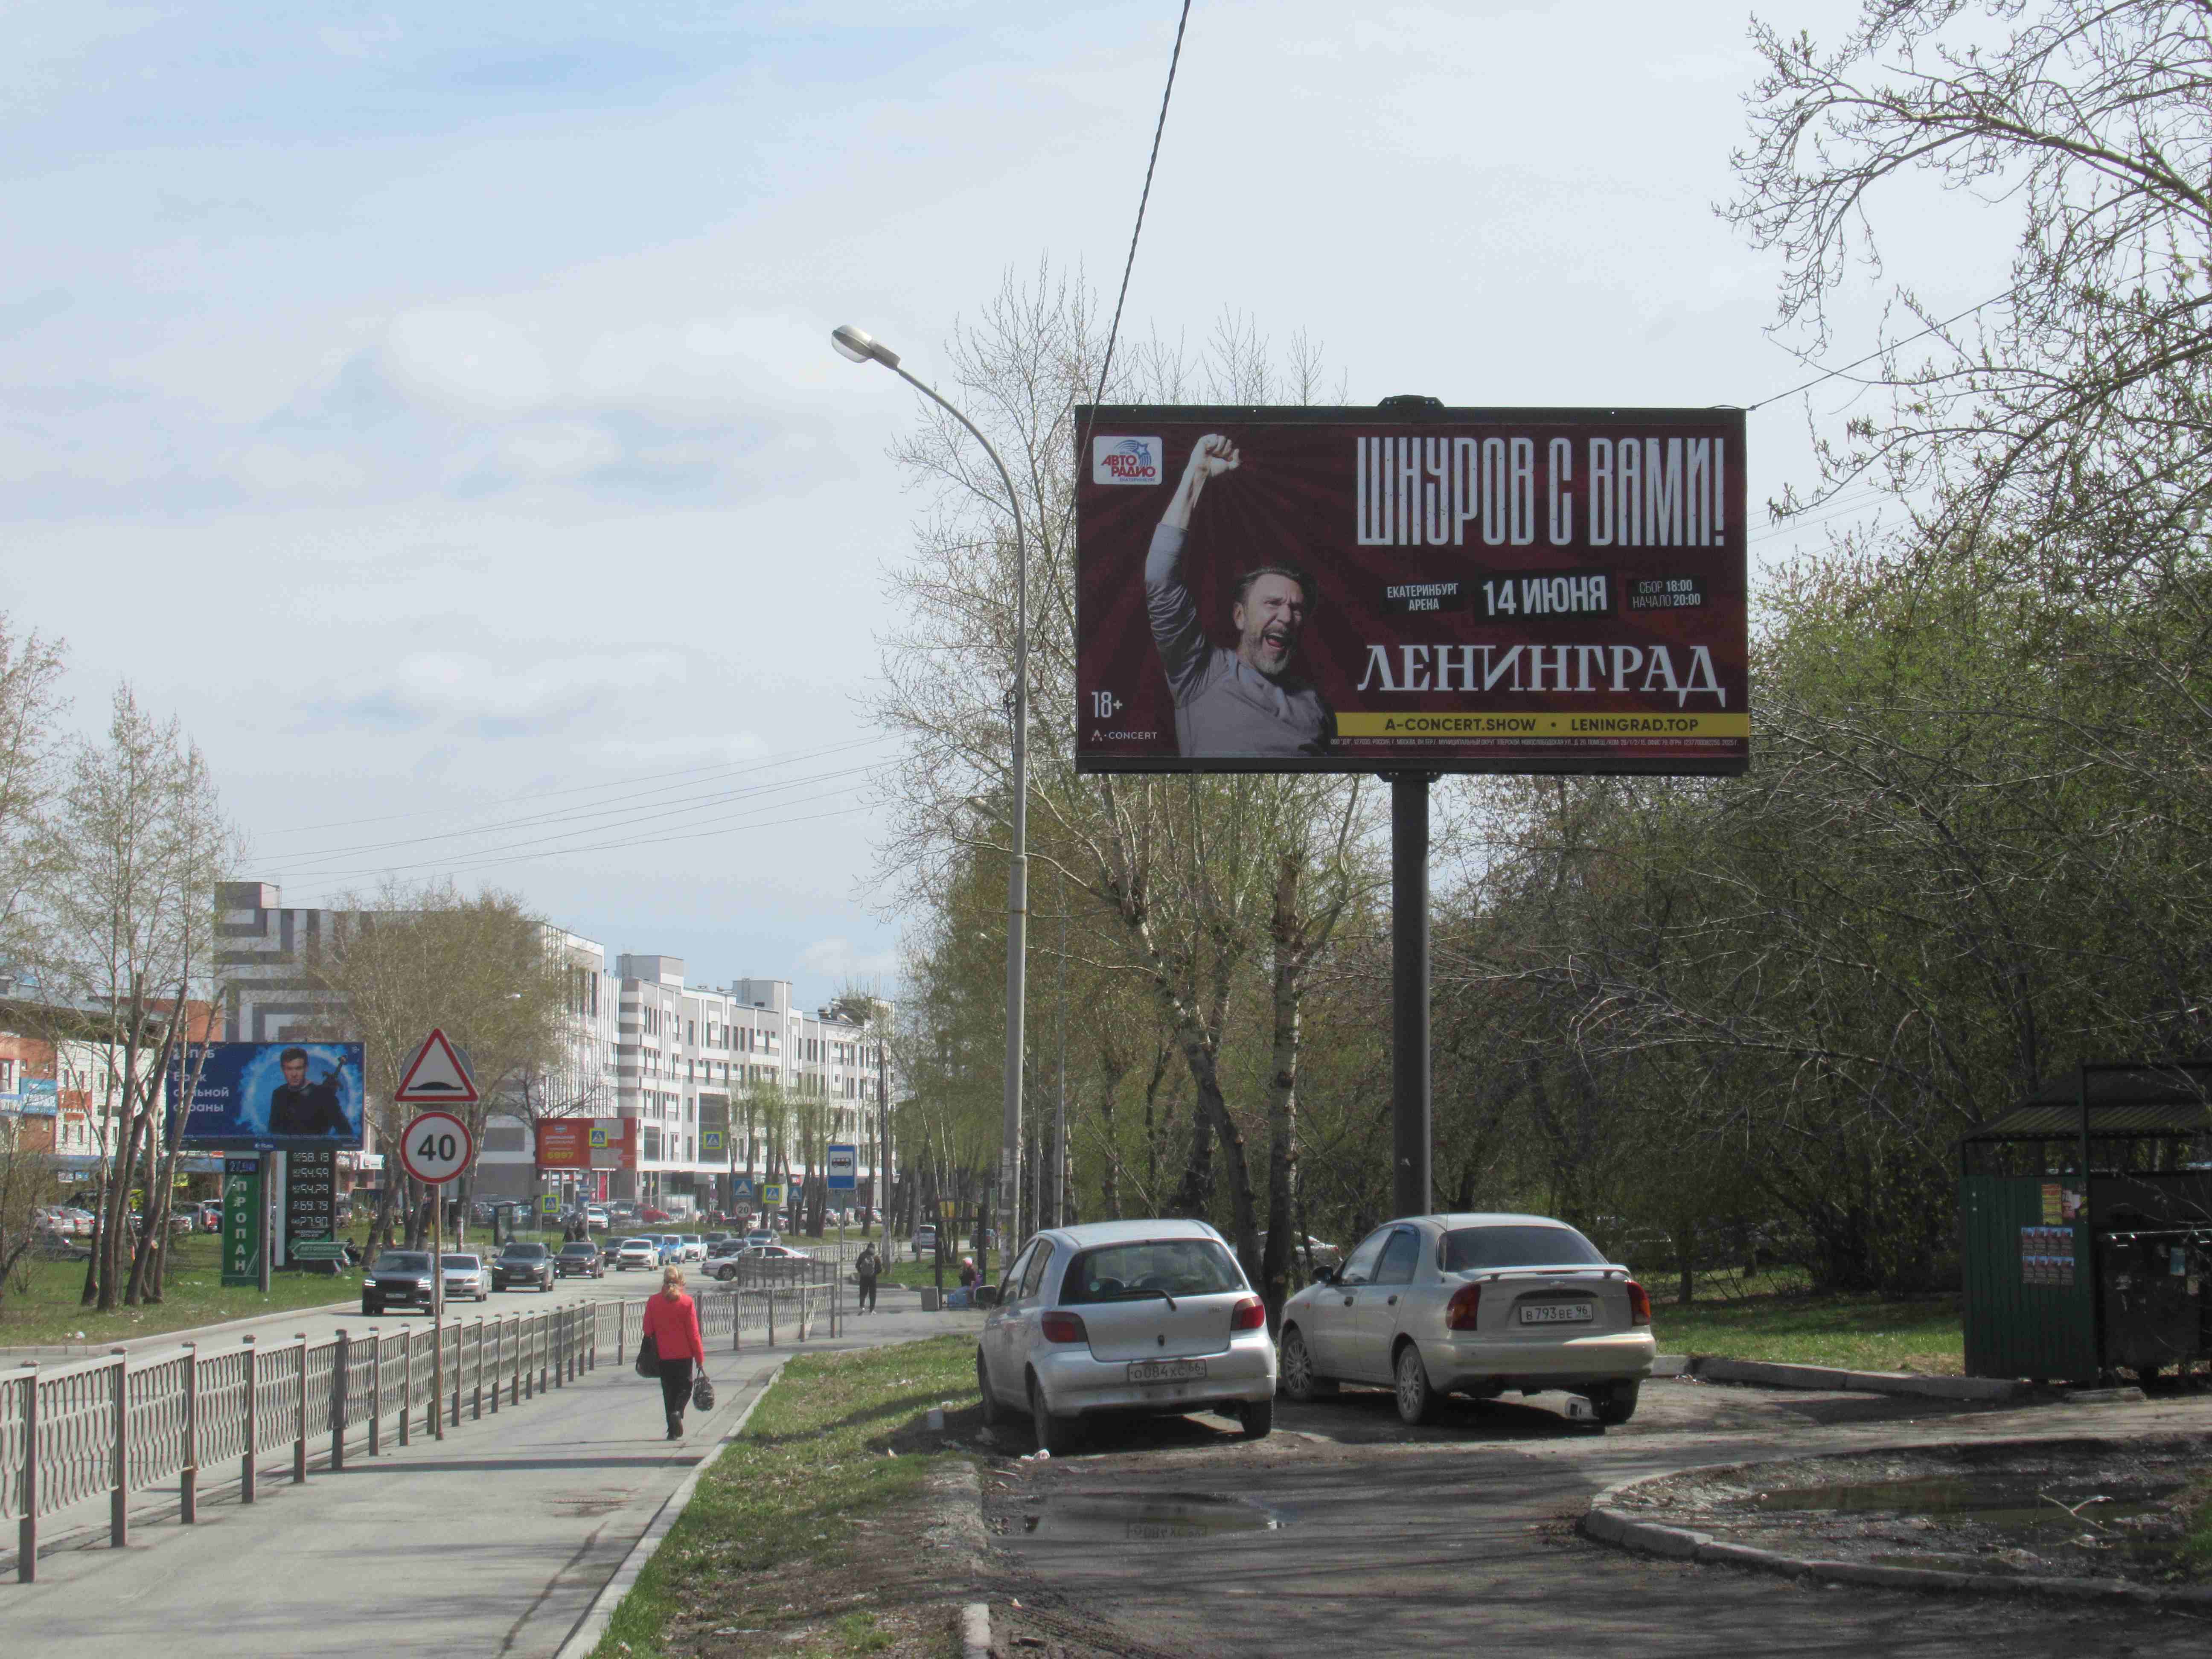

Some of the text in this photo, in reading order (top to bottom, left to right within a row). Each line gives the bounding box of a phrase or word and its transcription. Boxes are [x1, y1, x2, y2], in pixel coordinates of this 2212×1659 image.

[1100, 455, 1137, 466] АВТО
[1112, 466, 1156, 477] РАДИО
[1357, 437, 1724, 546] ШНУРОВ С ВАМИ!
[1387, 582, 1458, 598] ЕКАТЕРИНБУРГ
[1639, 579, 1693, 593] СБОР 18:00
[1483, 575, 1607, 615] 14 ИЮНЯ
[1633, 593, 1700, 608] НАЧАЛО 20:00
[1409, 598, 1439, 611] АРЕНА
[1357, 645, 1725, 708] ЛЕНИНГРАД
[1091, 691, 1123, 718] 18+
[1385, 718, 1699, 732] A-CONCERT.SHOW LENINGRAD.TOP
[417, 1133, 456, 1161] 40
[236, 1181, 247, 1271] ПРОПАН
[1576, 1306, 1588, 1315] 96
